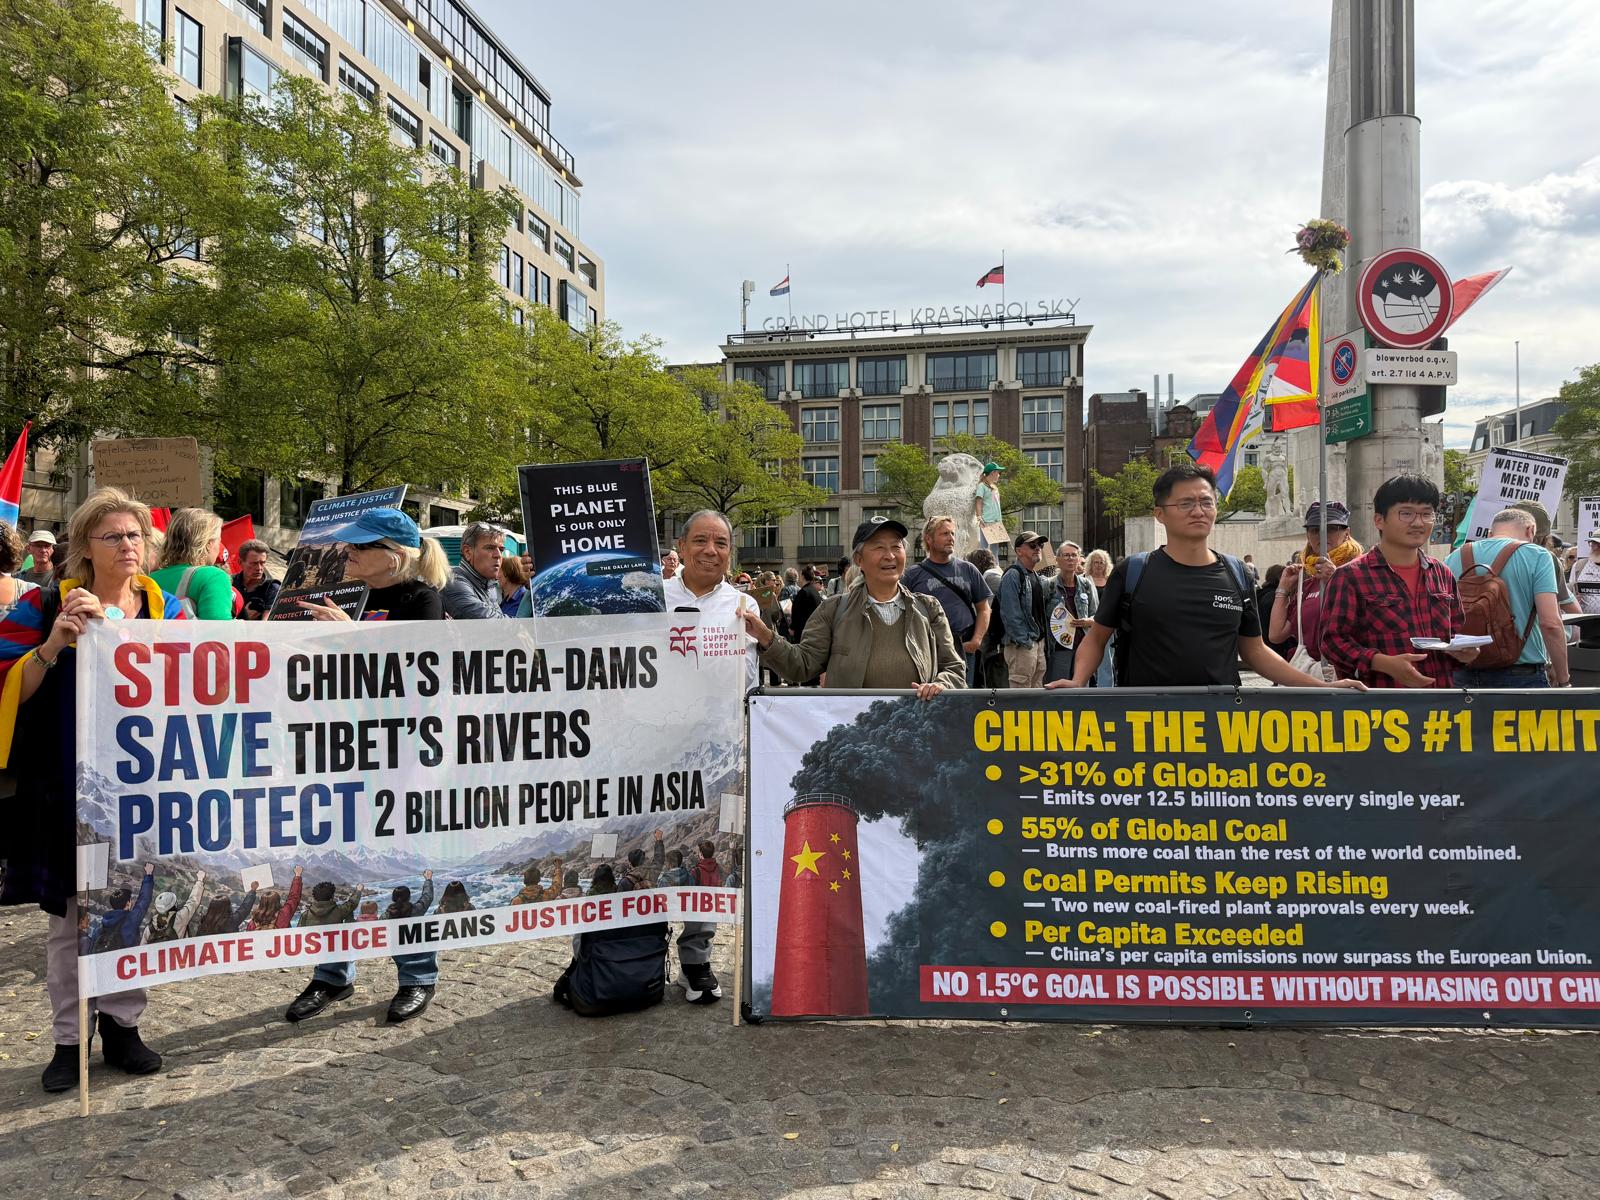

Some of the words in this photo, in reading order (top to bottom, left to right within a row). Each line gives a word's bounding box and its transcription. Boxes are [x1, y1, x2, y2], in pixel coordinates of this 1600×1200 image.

[763, 314, 829, 332] GRAND
[836, 310, 901, 328] HOTEL
[911, 298, 1081, 324] KRASNAPOLSKY
[1376, 354, 1424, 362] blowverbod
[1405, 370, 1417, 378] lid
[1494, 458, 1530, 474] WATER
[1533, 464, 1560, 478] VOOR
[554, 485, 583, 496] THIS
[587, 482, 618, 493] BLUE
[1500, 472, 1530, 488] MENS
[1533, 478, 1546, 490] EN
[318, 500, 356, 512] CLIMATE
[358, 492, 396, 506] JUSTICE
[1500, 486, 1540, 502] NATUUR
[305, 515, 330, 524] MEANS
[330, 510, 360, 522] JUSTICE
[550, 498, 627, 518] PLANET
[555, 524, 566, 533] IS
[570, 521, 594, 531] OUR
[598, 518, 626, 529] ONLY
[561, 534, 626, 554] HOME
[309, 591, 334, 600] TIBET'S
[334, 586, 364, 596] NOMADS
[1213, 595, 1234, 604] 100%
[273, 610, 302, 620] PROTECT
[702, 626, 726, 634] TIBET
[703, 634, 738, 642] SUPPORT
[114, 640, 271, 708] STOP
[287, 651, 440, 702] CHINA'S
[452, 645, 658, 696] MEGA-DAMS
[974, 710, 1116, 752] CHINA:
[1125, 711, 1207, 753] THE
[1216, 709, 1411, 753] WORLD'S
[1421, 710, 1473, 753] #1
[1492, 709, 1600, 752] EMIT
[115, 711, 273, 785] SAVE
[287, 715, 443, 775] TIBET'S
[457, 709, 591, 764] RIVERS
[1019, 761, 1106, 786] >31%
[1113, 762, 1146, 786] of
[1153, 762, 1258, 788] Global
[1042, 790, 1095, 806] Emits
[1100, 793, 1142, 806] over
[1148, 792, 1186, 806] 12.5
[1190, 791, 1251, 808] billion
[1256, 792, 1298, 808] tons
[1302, 793, 1354, 811] every
[1359, 790, 1414, 811] single
[1419, 793, 1465, 811] year.
[118, 781, 365, 860] PROTECT
[375, 789, 396, 837] 2
[405, 784, 510, 835] BILLION
[518, 778, 609, 825] PEOPLE
[618, 774, 643, 816] IN
[650, 769, 706, 813] ASIA
[1021, 816, 1084, 840] 55%
[1090, 817, 1120, 840] of
[1126, 818, 1218, 841] Global
[1224, 819, 1288, 842] Coal
[1046, 843, 1099, 858] Burns
[1102, 846, 1148, 860] more
[1152, 845, 1190, 860] coal
[1194, 845, 1237, 860] than
[1241, 846, 1269, 860] the
[1275, 846, 1310, 860] rest
[1315, 846, 1333, 860] of
[1338, 846, 1367, 860] the
[1372, 846, 1424, 860] world
[1428, 846, 1522, 861] combined.
[1022, 868, 1086, 892] Coal
[1094, 869, 1207, 894] Permits
[1215, 871, 1288, 900] Keep
[1296, 870, 1389, 900] Rising
[1052, 898, 1088, 913] Two
[1093, 901, 1130, 914] new
[1134, 900, 1221, 915] coal-fired
[1226, 900, 1272, 918] plant
[1276, 900, 1365, 918] approvals
[1370, 904, 1419, 918] every
[1424, 900, 1475, 916] week.
[116, 937, 254, 980] CLIMATE
[265, 926, 387, 958] JUSTICE
[398, 914, 495, 946] MEANS
[505, 902, 613, 933] JUSTICE
[622, 893, 668, 918] FOR
[677, 892, 737, 914] TIBET
[1024, 920, 1071, 943] Per
[1078, 920, 1167, 948] Capita
[1174, 922, 1304, 946] Exceeded
[1050, 946, 1116, 962] China's
[1120, 950, 1150, 965] per
[1154, 948, 1208, 966] capita
[1212, 950, 1298, 964] emissions
[1302, 952, 1338, 964] now
[1343, 952, 1412, 967] surpass
[1416, 950, 1446, 964] the
[1450, 950, 1532, 967] European
[1536, 950, 1592, 964] Union.
[932, 971, 969, 996] NO
[1046, 974, 1110, 999] GOAL
[1116, 974, 1141, 1000] IS
[1148, 976, 1265, 1000] POSSIBLE
[1270, 976, 1384, 1002] WITHOUT
[1390, 976, 1498, 1002] PHASING
[1504, 977, 1553, 1002] OUT
[1559, 977, 1600, 1003] CHI
